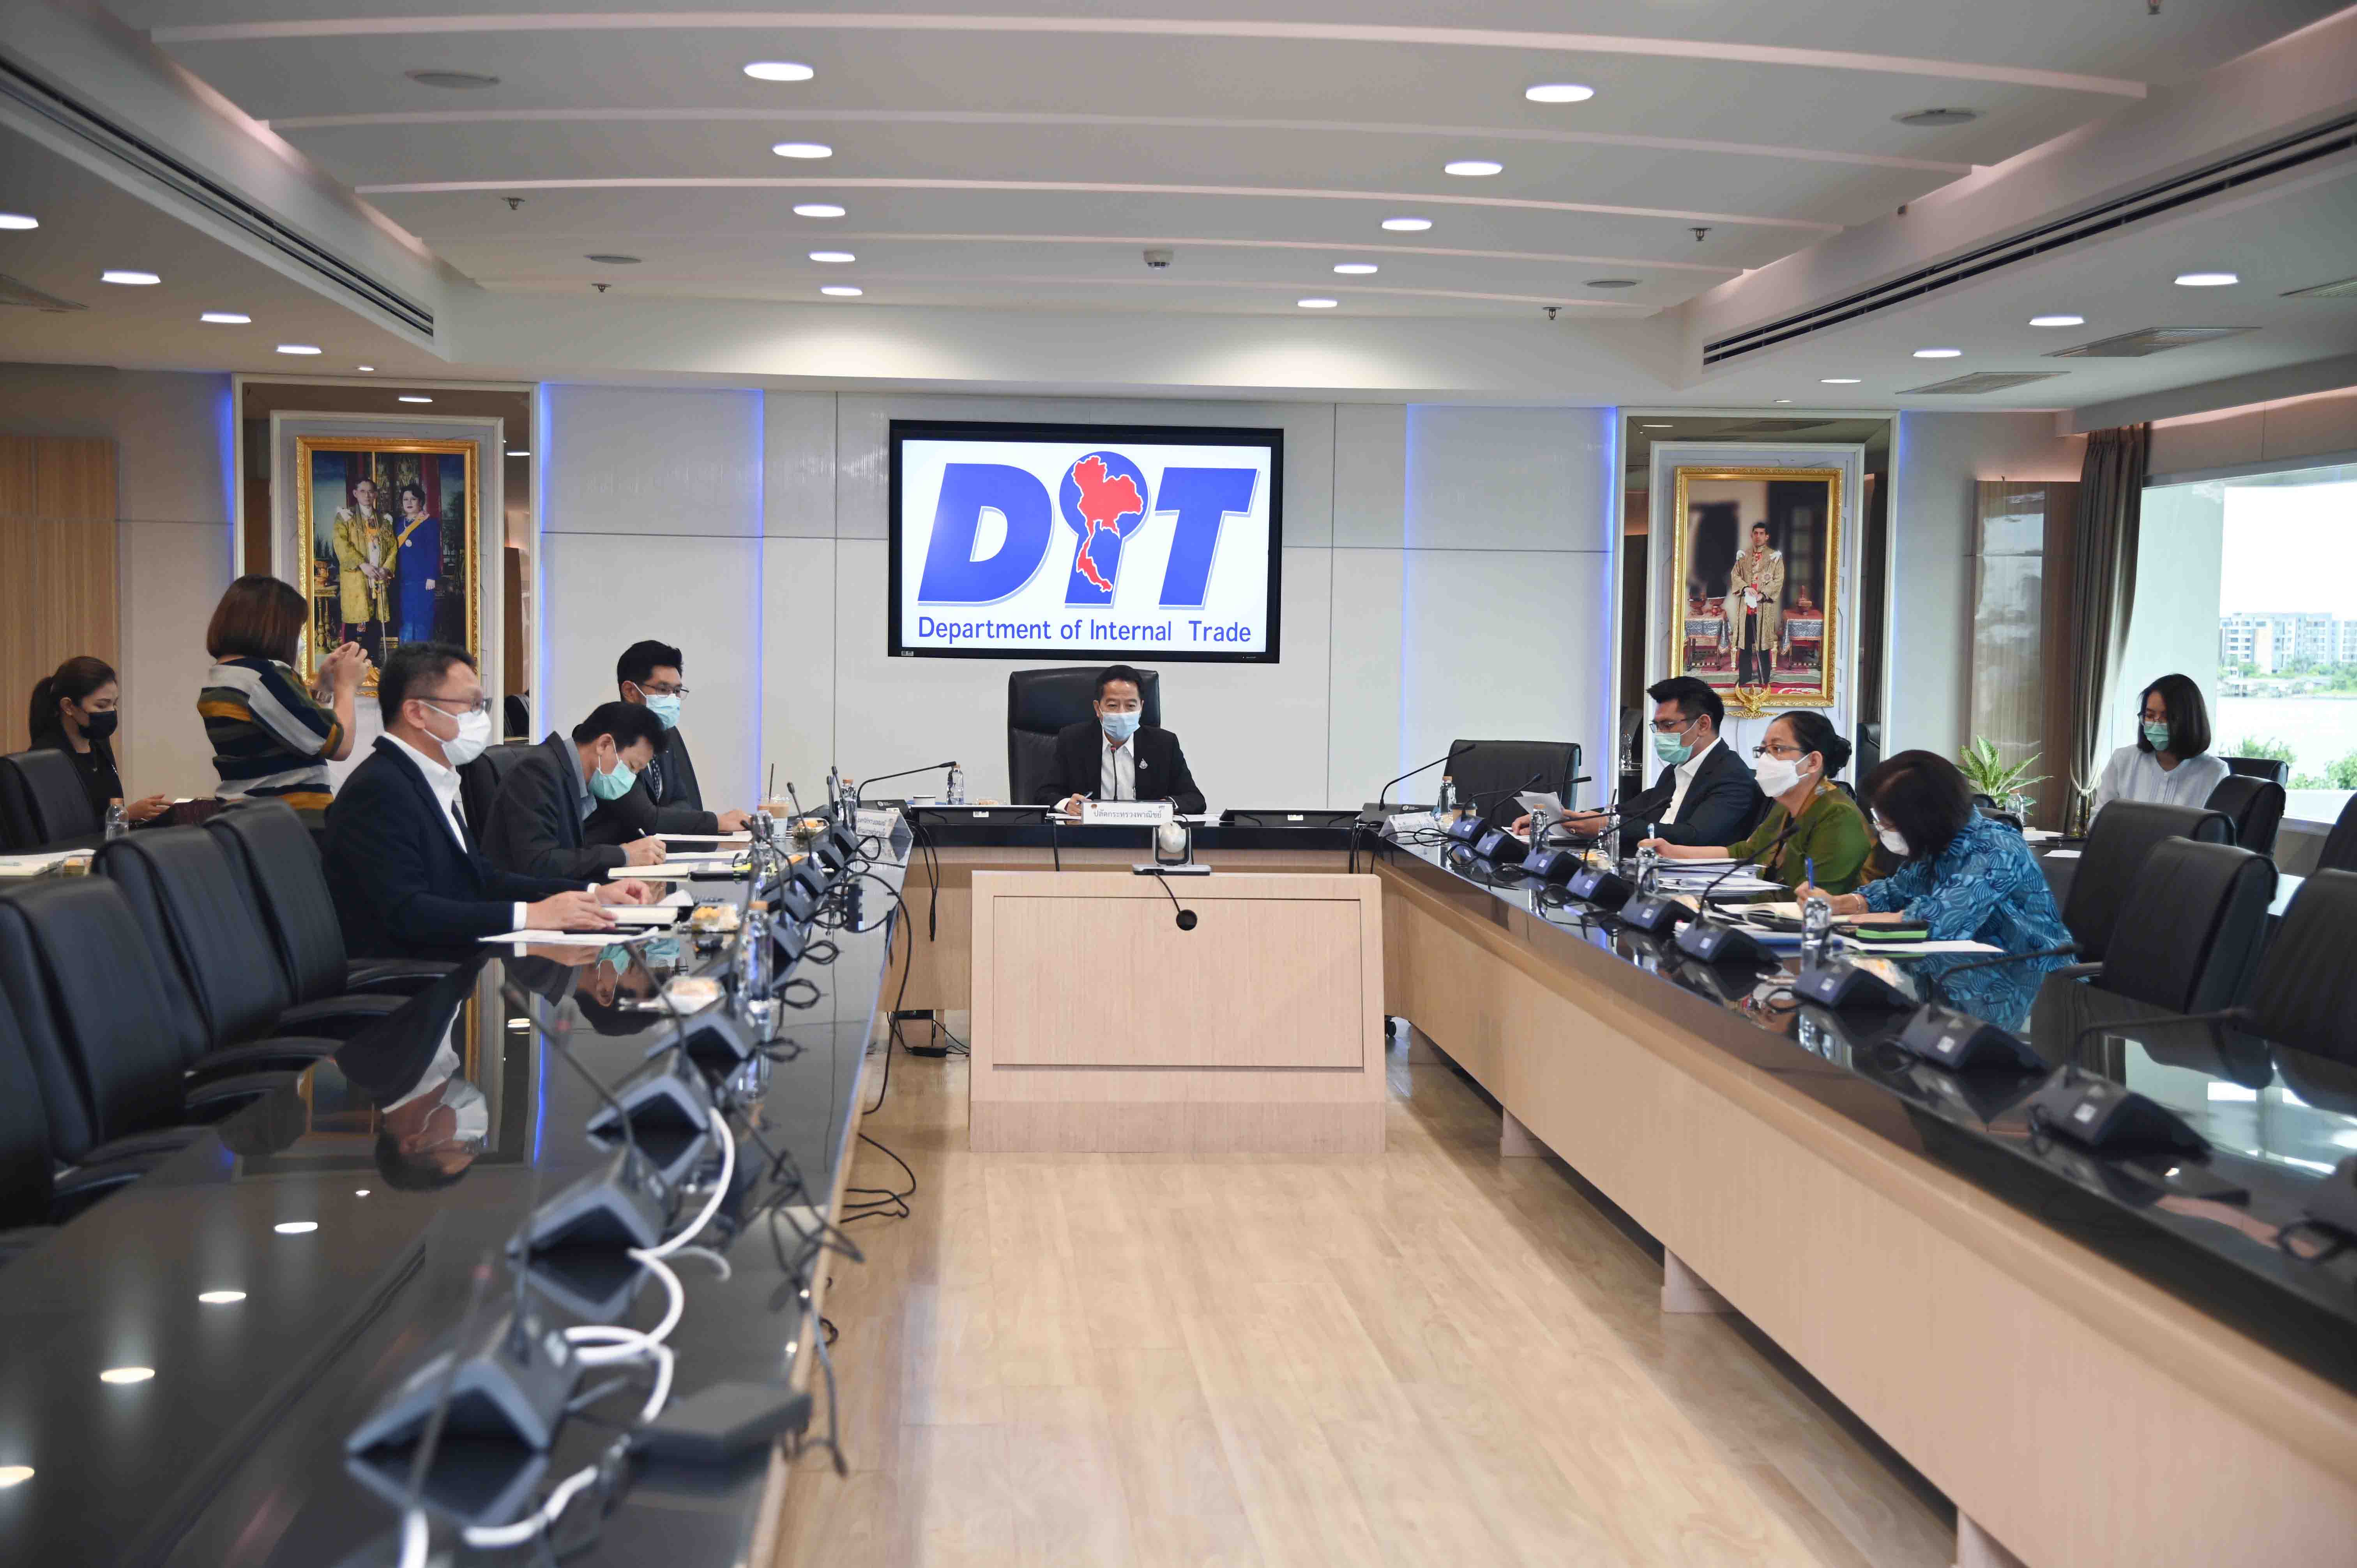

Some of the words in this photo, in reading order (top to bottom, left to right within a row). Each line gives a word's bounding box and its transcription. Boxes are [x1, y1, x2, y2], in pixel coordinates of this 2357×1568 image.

[919, 616, 1051, 645] Department
[1060, 619, 1083, 640] of
[1090, 619, 1171, 641] Internal
[1188, 620, 1251, 642] Trade
[1094, 809, 1161, 818] ปลัดกระทรวงพาณิชย์
